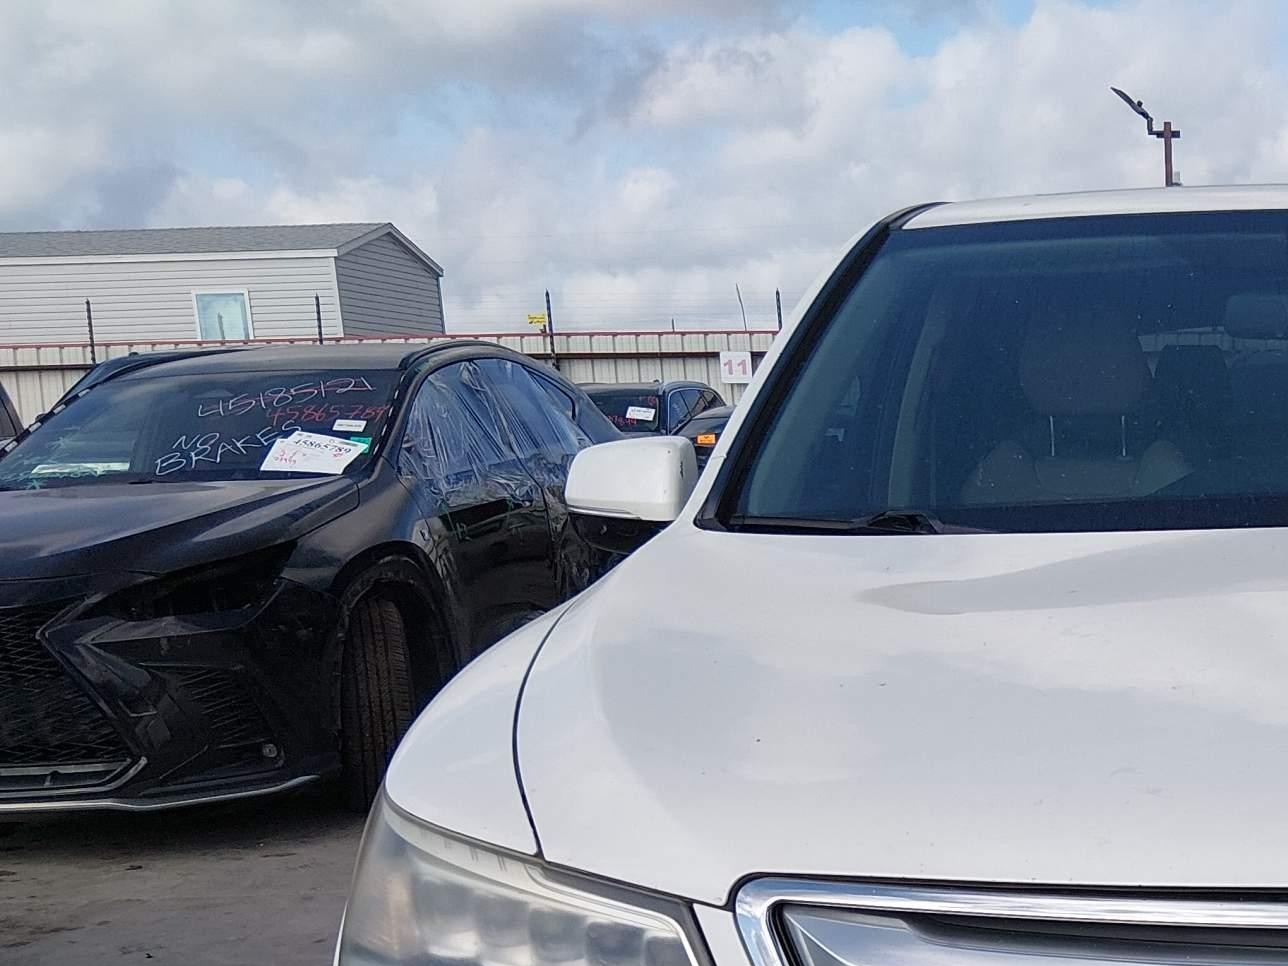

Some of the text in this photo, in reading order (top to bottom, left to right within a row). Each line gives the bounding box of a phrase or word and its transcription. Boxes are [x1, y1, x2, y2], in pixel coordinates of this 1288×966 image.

[723, 359, 747, 376] 11
[198, 376, 374, 417] 45185121
[154, 419, 302, 476] BRAKES
[173, 432, 220, 450] NO
